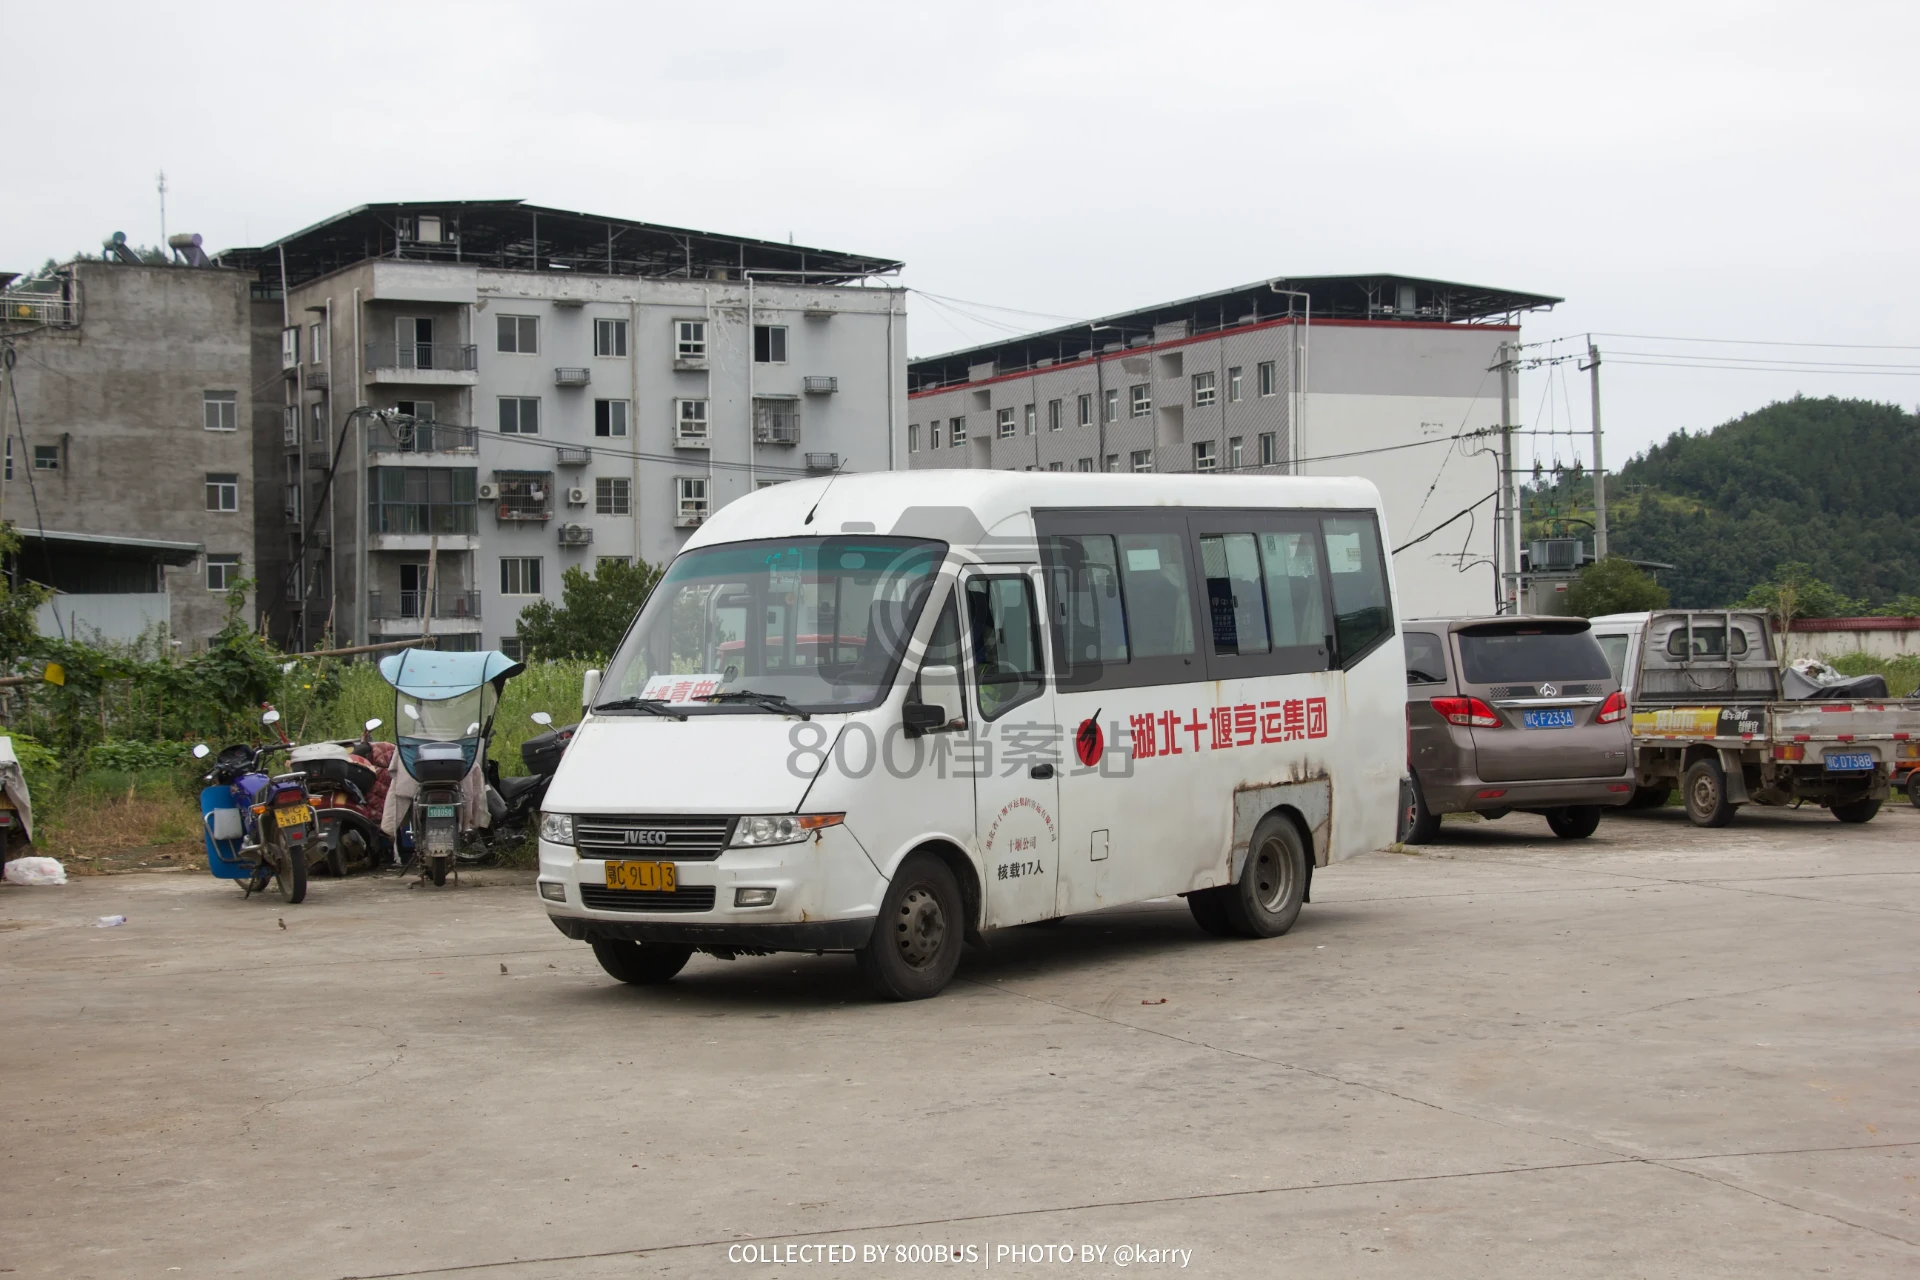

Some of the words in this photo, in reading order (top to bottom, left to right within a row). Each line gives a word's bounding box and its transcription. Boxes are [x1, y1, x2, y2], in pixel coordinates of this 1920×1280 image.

[1129, 697, 1327, 759] 湖北十堰亨运集团
[624, 831, 666, 844] IVECO
[997, 860, 1044, 881] 核载17人
